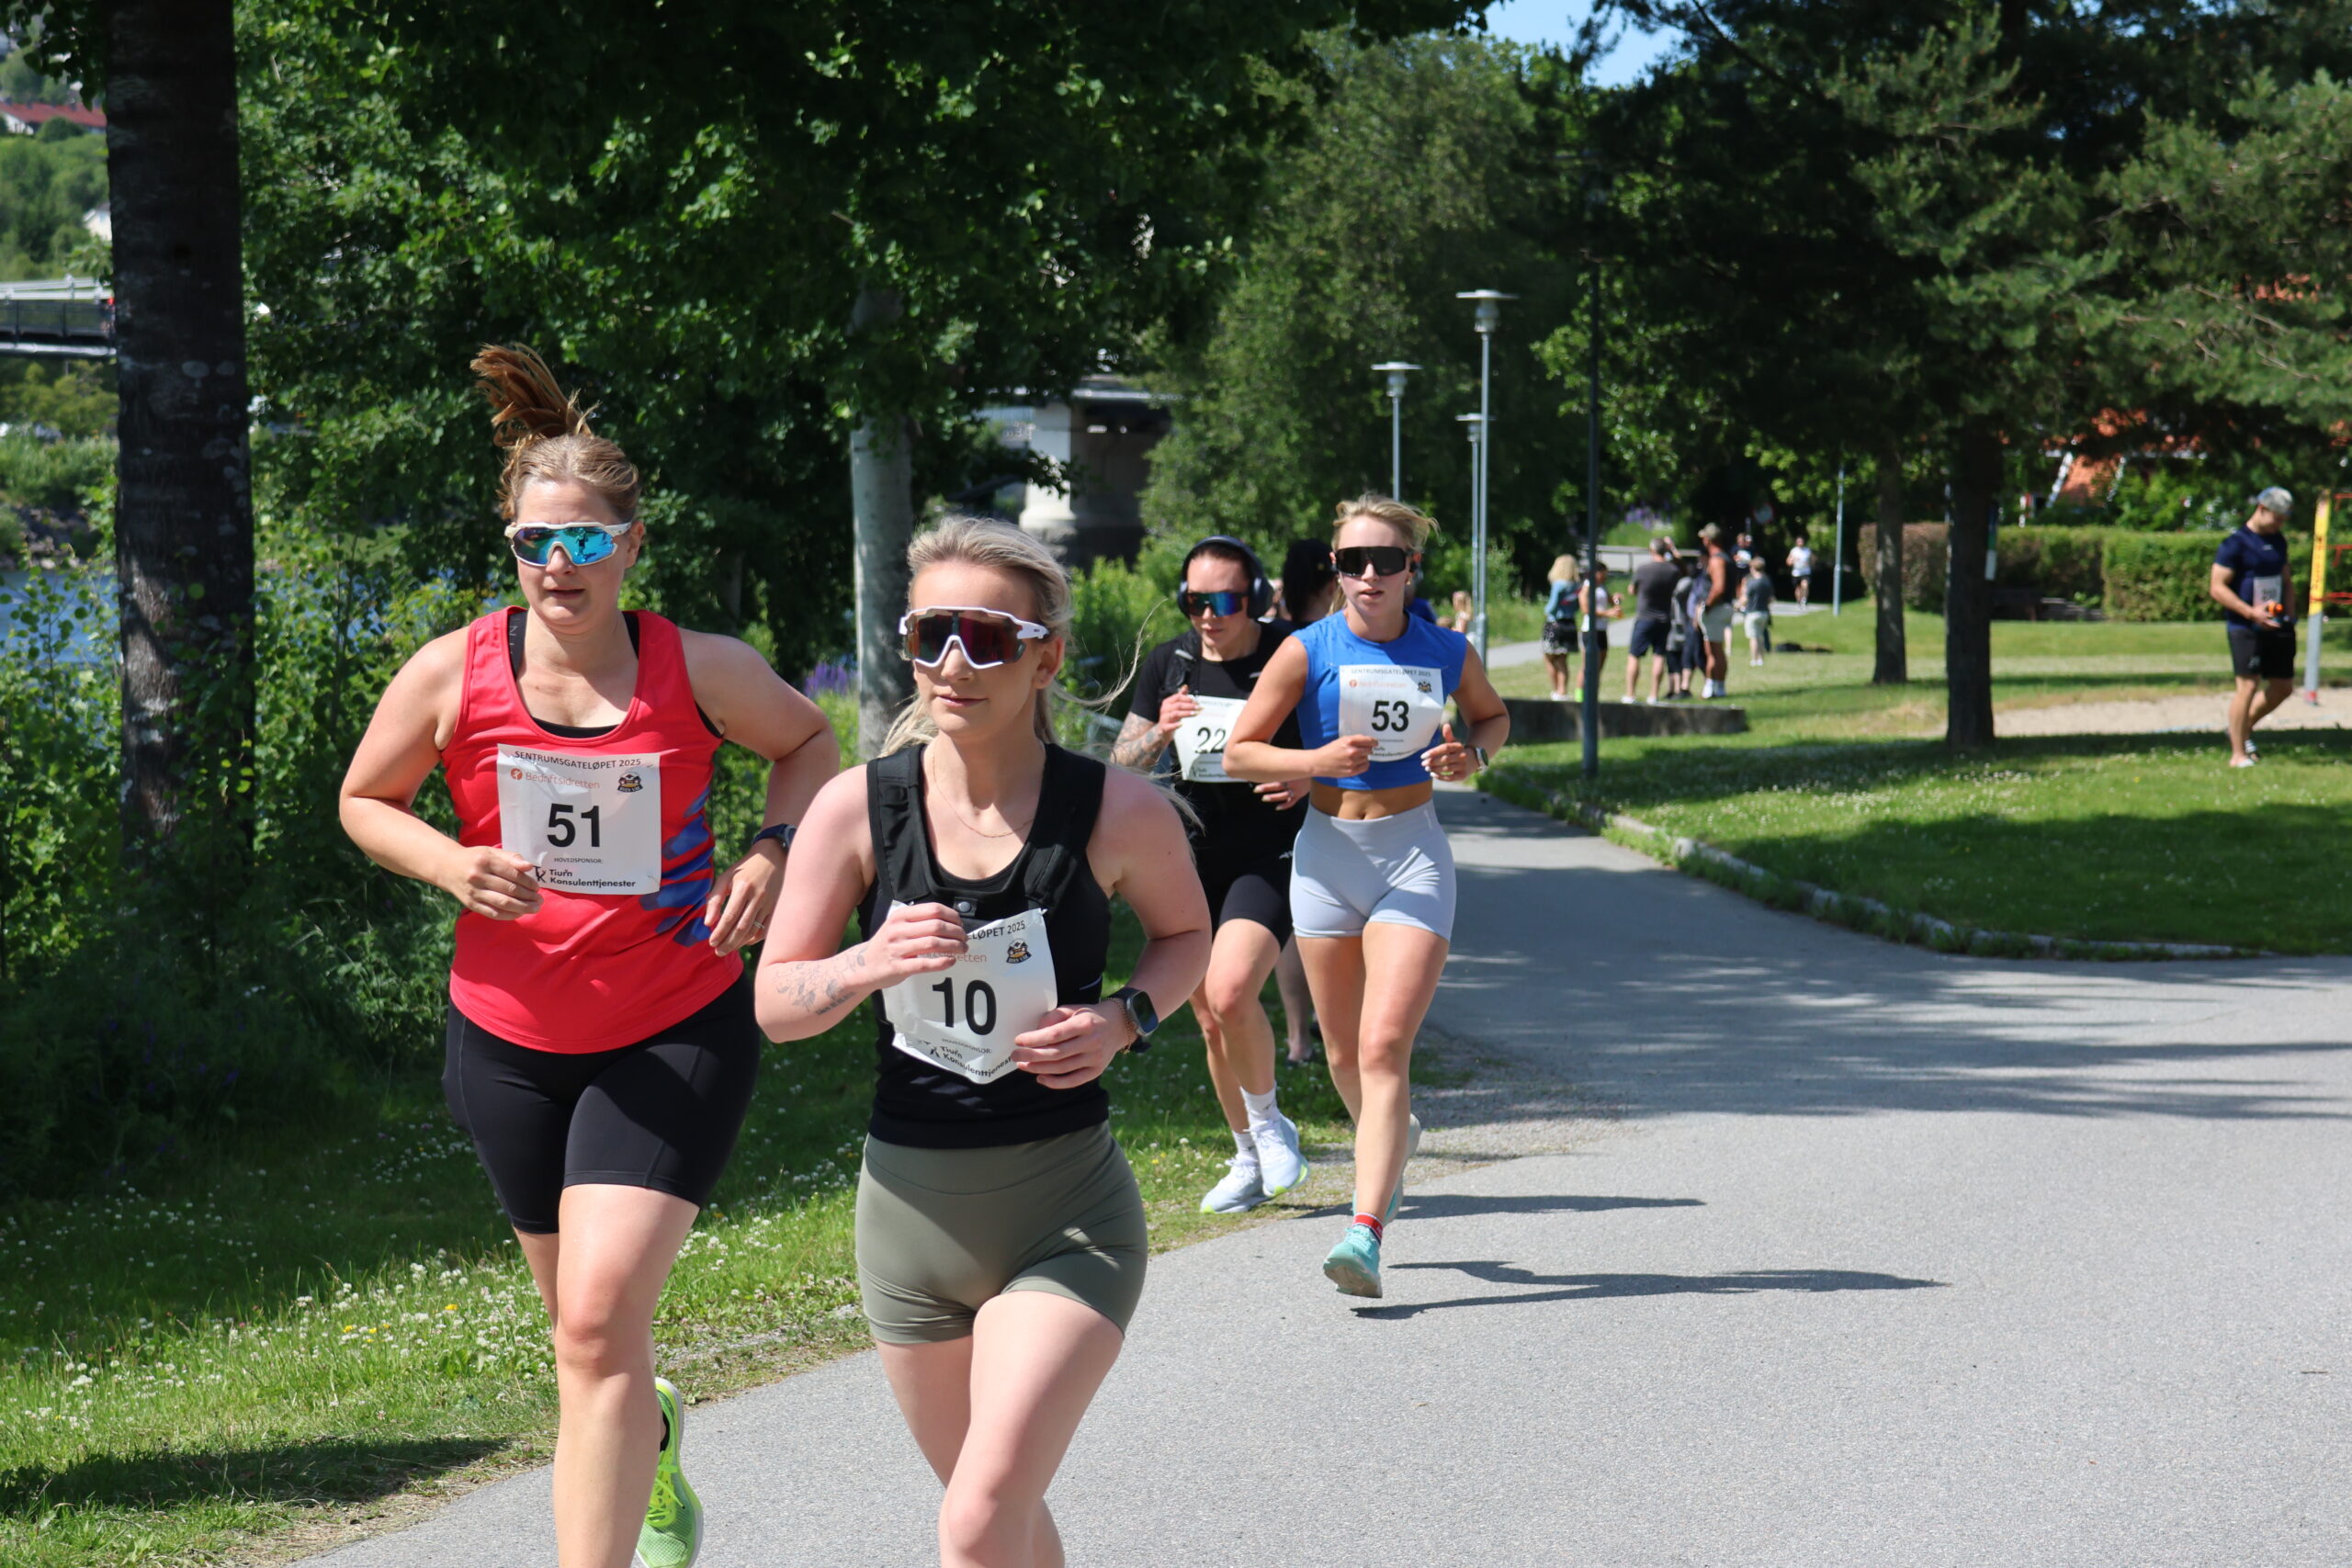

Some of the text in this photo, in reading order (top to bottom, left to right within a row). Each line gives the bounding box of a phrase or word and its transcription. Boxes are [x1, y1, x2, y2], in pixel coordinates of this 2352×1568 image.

[1371, 700, 1410, 732] 53
[514, 750, 641, 770] SENTRUMSGATELØPET 2025
[525, 772, 600, 789] Bedriftsidretten
[547, 802, 602, 848] 51
[549, 876, 637, 888] Konsulenttjenester
[1007, 919, 1026, 934] 2025
[932, 976, 998, 1036] 10
